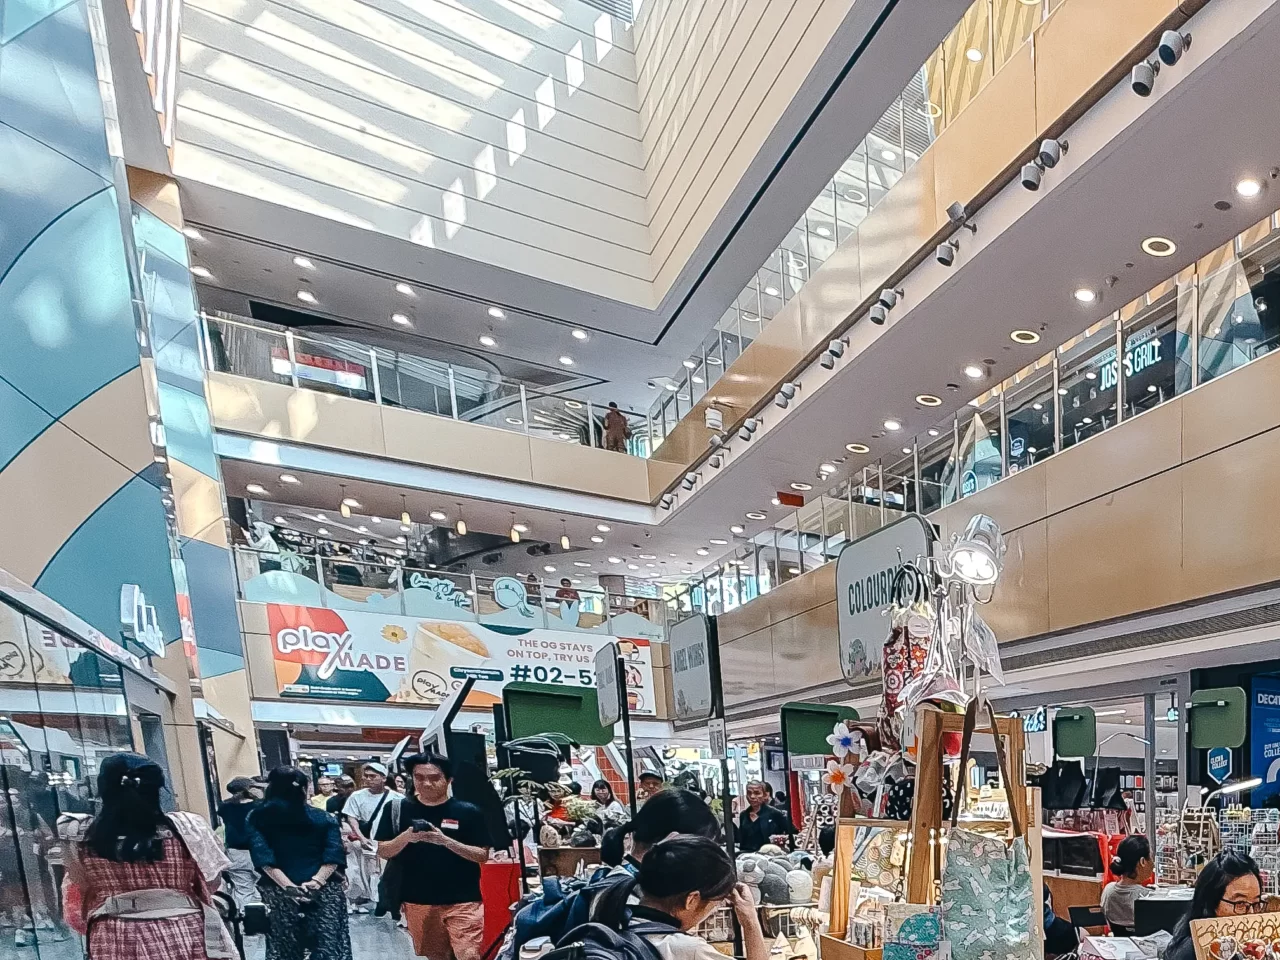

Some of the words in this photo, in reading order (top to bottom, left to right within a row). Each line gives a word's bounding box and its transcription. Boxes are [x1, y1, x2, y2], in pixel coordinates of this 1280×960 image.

[1100, 352, 1133, 391] JOSS
[1134, 340, 1162, 372] GRILL
[280, 628, 352, 676] play
[338, 652, 406, 672] MADE
[507, 649, 527, 659] ON
[529, 651, 551, 662] TOP,
[554, 654, 574, 663] TRY
[576, 655, 590, 664] US
[517, 638, 538, 648] THE
[540, 640, 557, 650] OG
[559, 642, 593, 653] STAYS
[510, 664, 597, 687] #02-5
